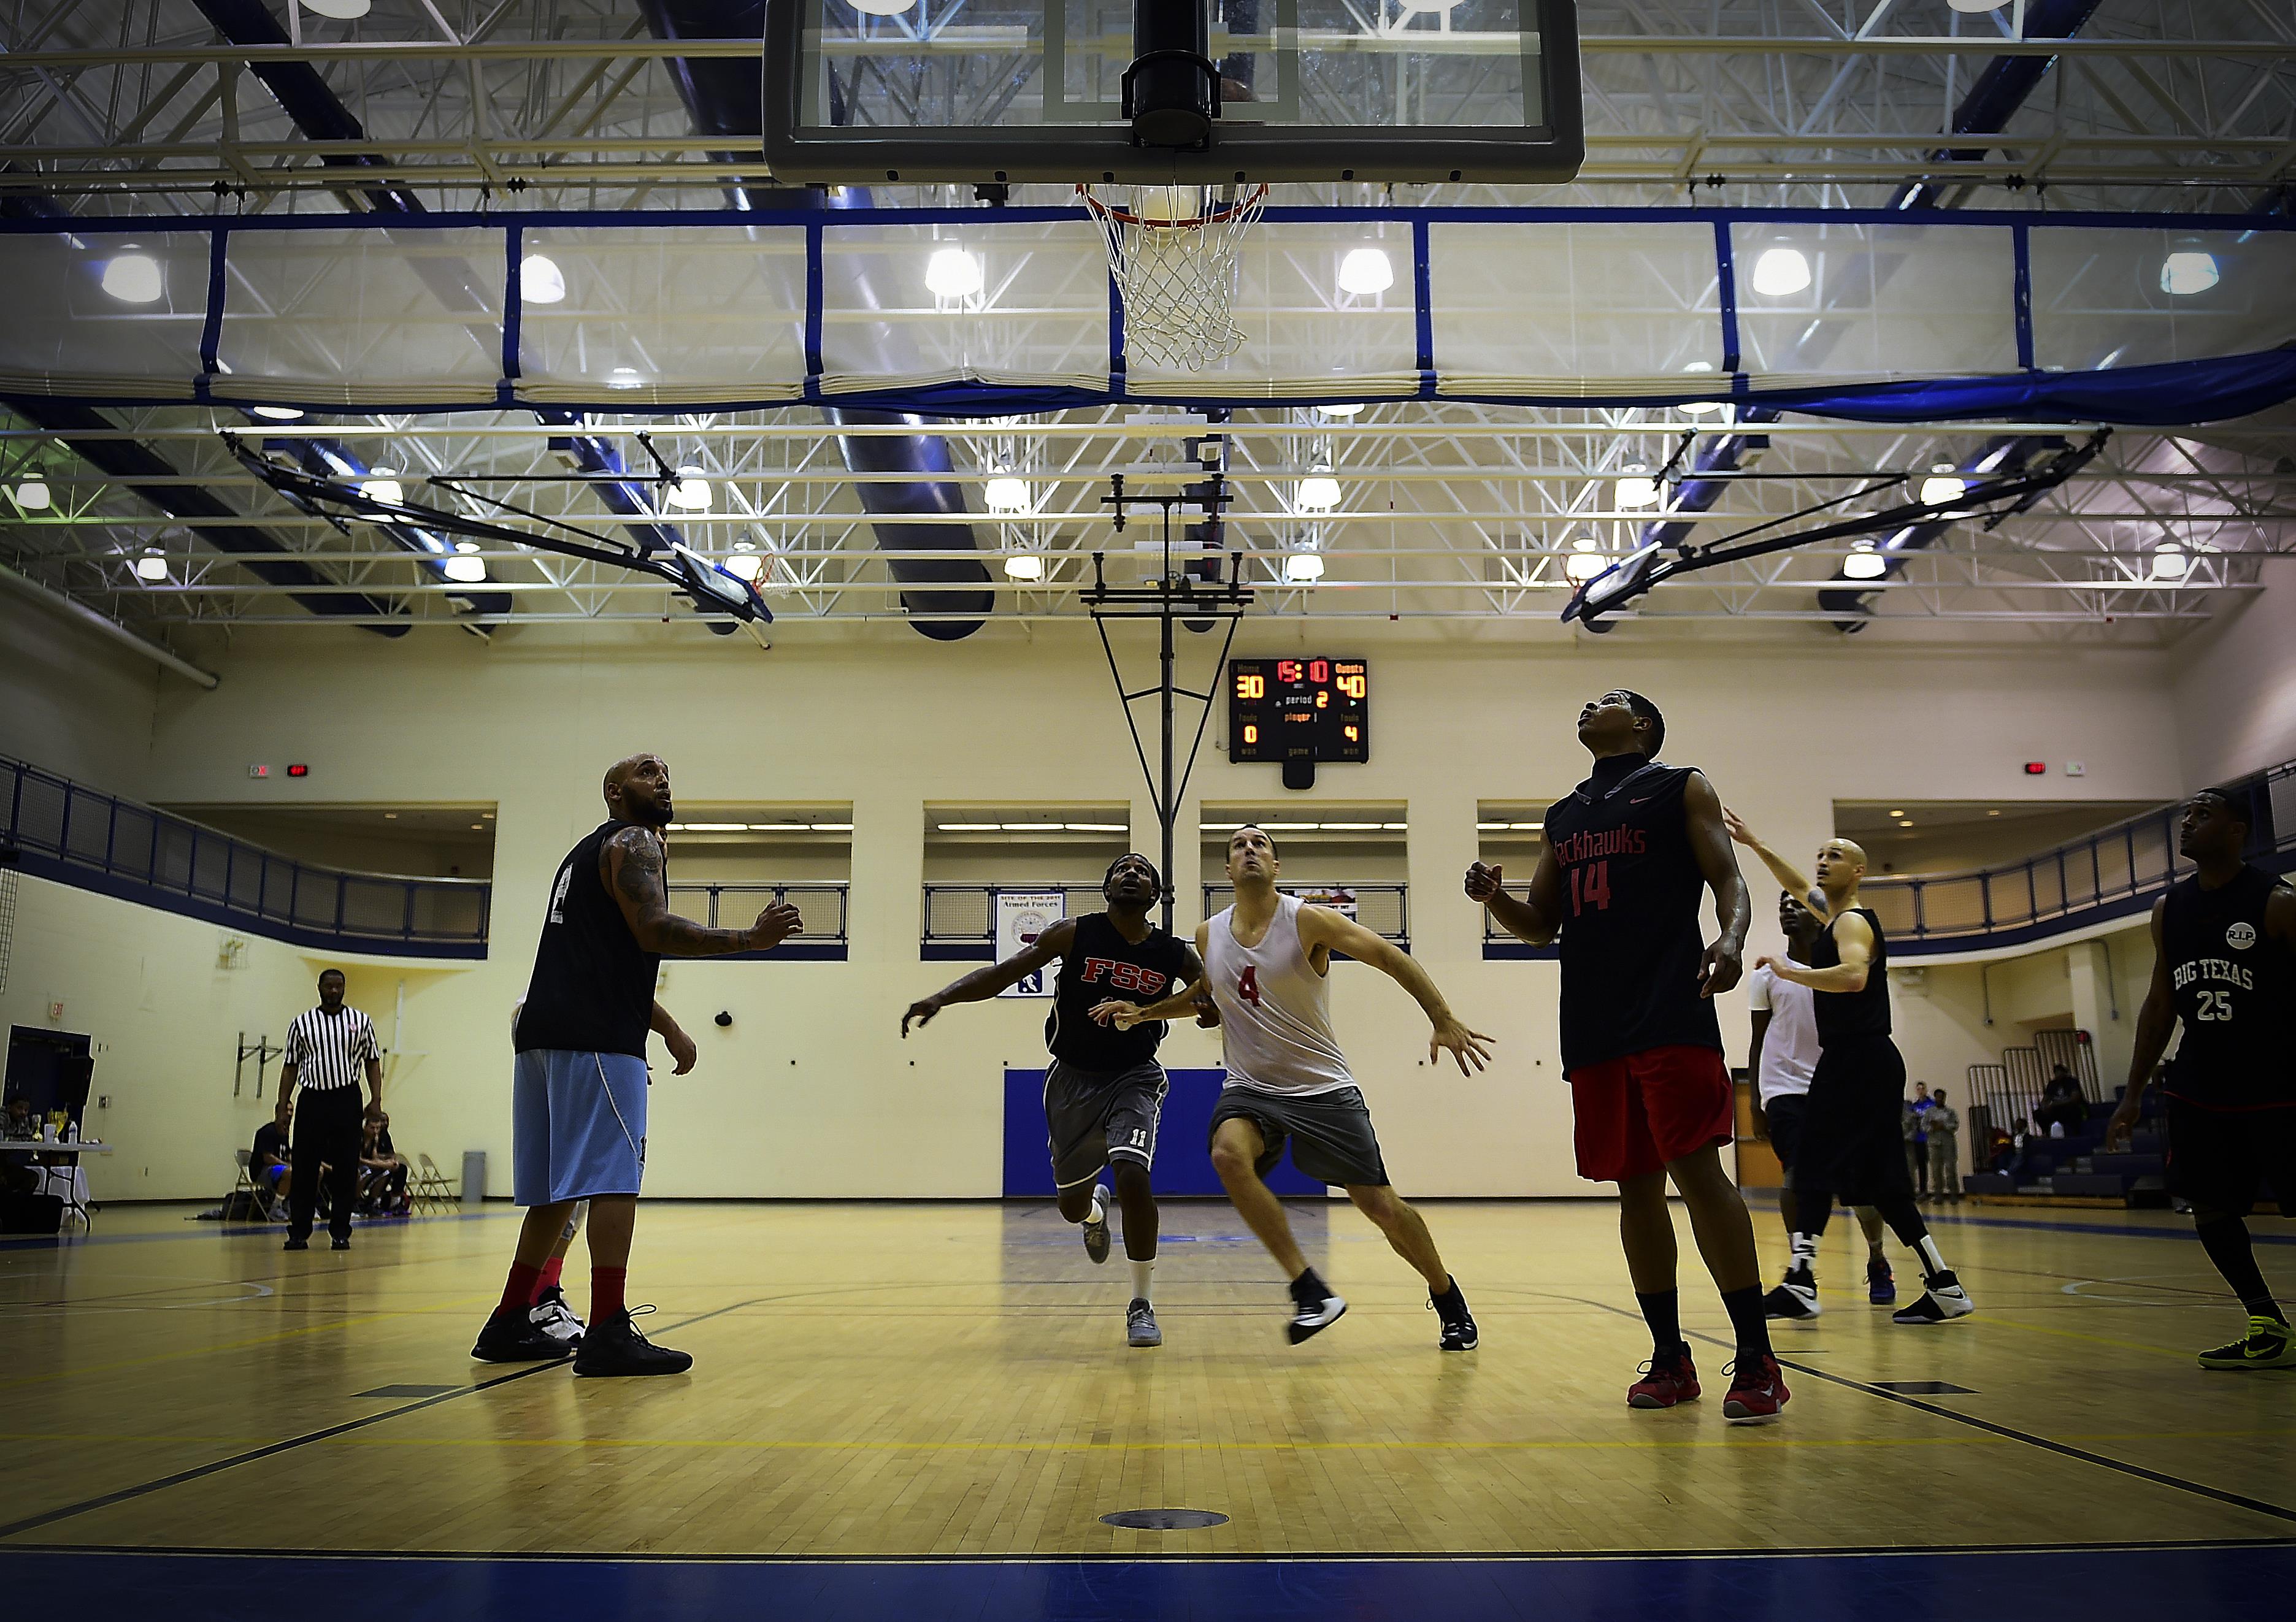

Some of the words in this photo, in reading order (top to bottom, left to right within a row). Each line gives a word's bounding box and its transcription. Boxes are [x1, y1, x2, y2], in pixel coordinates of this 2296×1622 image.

[1278, 660, 1328, 683] 15:10
[1237, 676, 1264, 698] 30
[1337, 676, 1365, 698] 40
[1285, 695, 1312, 705] period
[1316, 691, 1328, 708] 2
[1244, 725, 1257, 743] 0
[1345, 726, 1357, 742] 4
[1571, 860, 1611, 917] 14
[1081, 957, 1167, 995] FSS
[2173, 961, 2197, 990] BIG
[2199, 958, 2253, 990] TEXAS
[1238, 966, 1261, 1006] 4
[2197, 990, 2233, 1021] 25
[1129, 1128, 1147, 1147] 11
